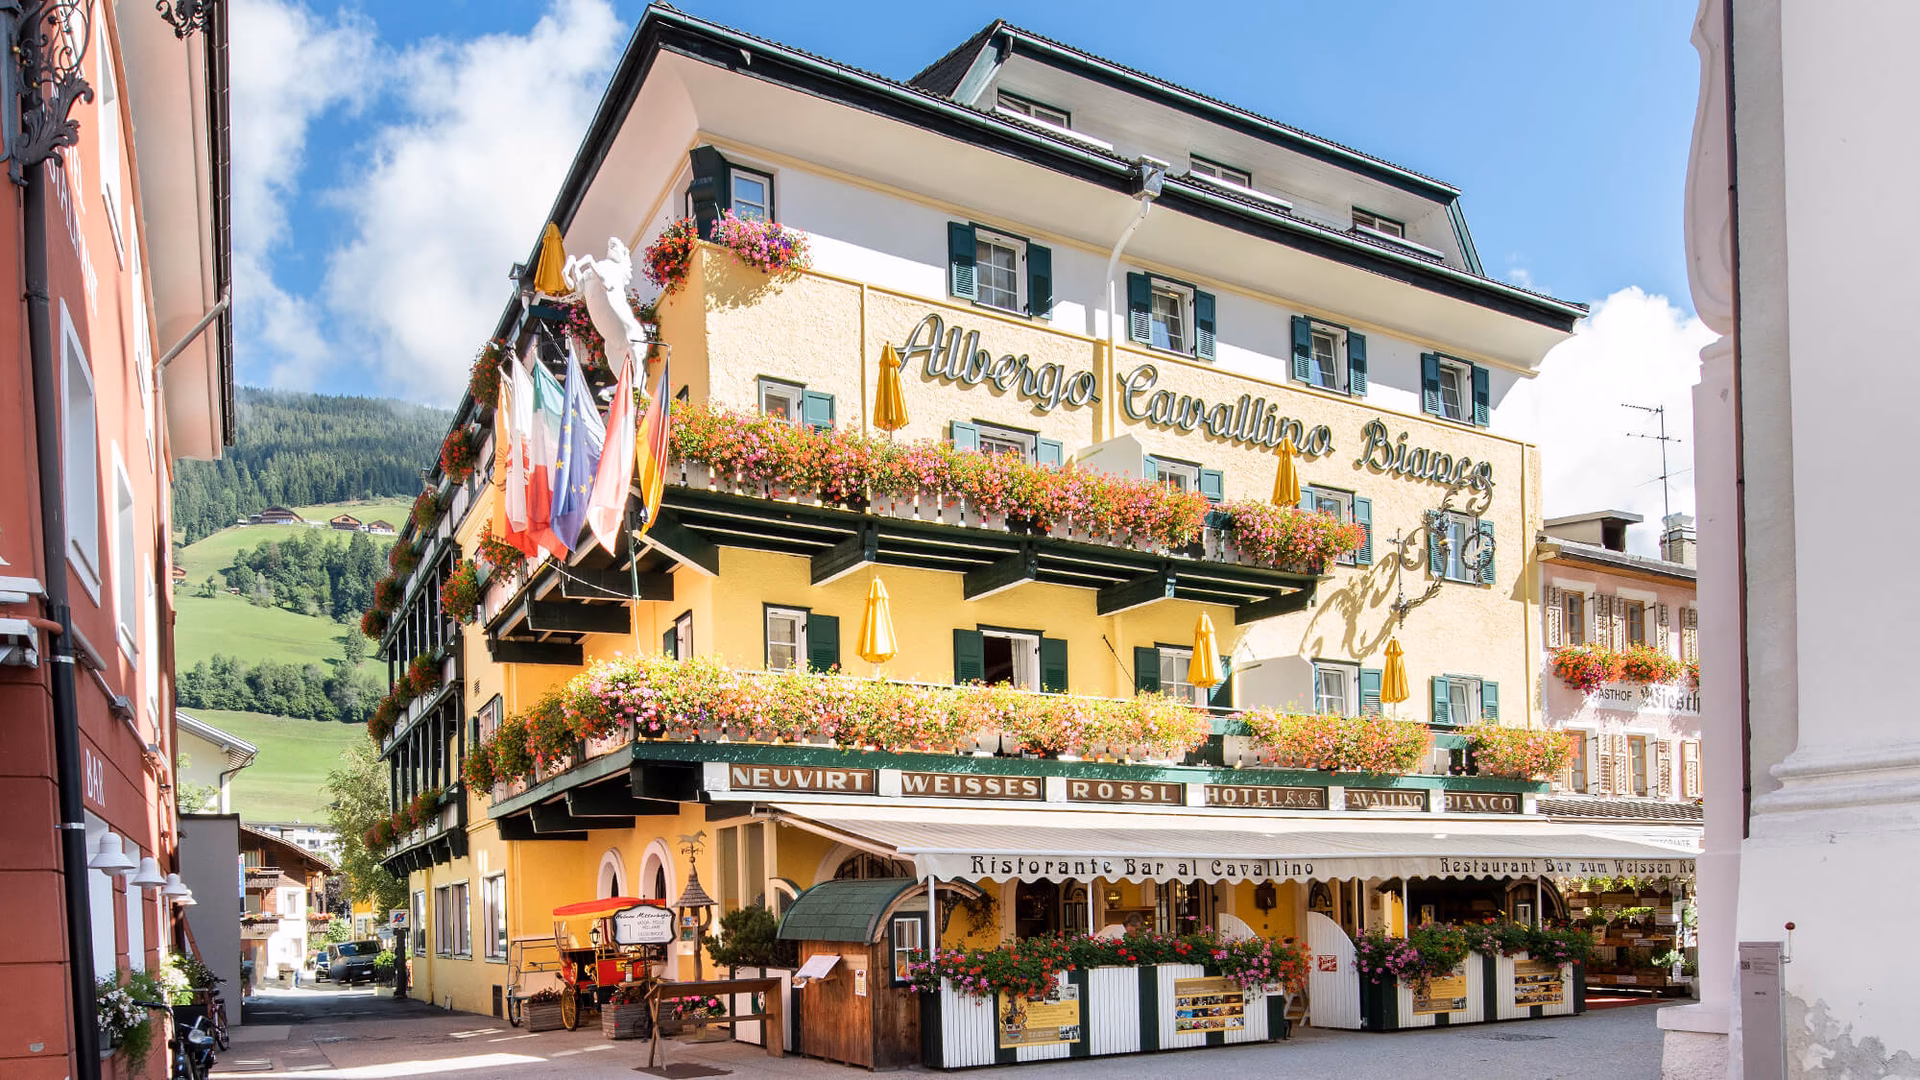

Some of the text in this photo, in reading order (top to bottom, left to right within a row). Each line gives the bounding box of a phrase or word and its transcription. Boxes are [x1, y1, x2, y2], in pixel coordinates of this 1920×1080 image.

[893, 313, 1496, 492] Albergo Cavallino Bianco
[86, 748, 106, 807] BAR
[731, 766, 871, 791] NEUVIRT
[901, 773, 1039, 796] WEISSES
[1205, 787, 1283, 805] HOTEL
[1444, 795, 1513, 811] BIANCO
[971, 855, 1314, 876] Ristorante Bar al Cavallino
[1440, 857, 1536, 873] Restaurant
[1543, 858, 1571, 873] Bar
[1580, 860, 1608, 874] zum
[1615, 858, 1672, 874] Weissen
